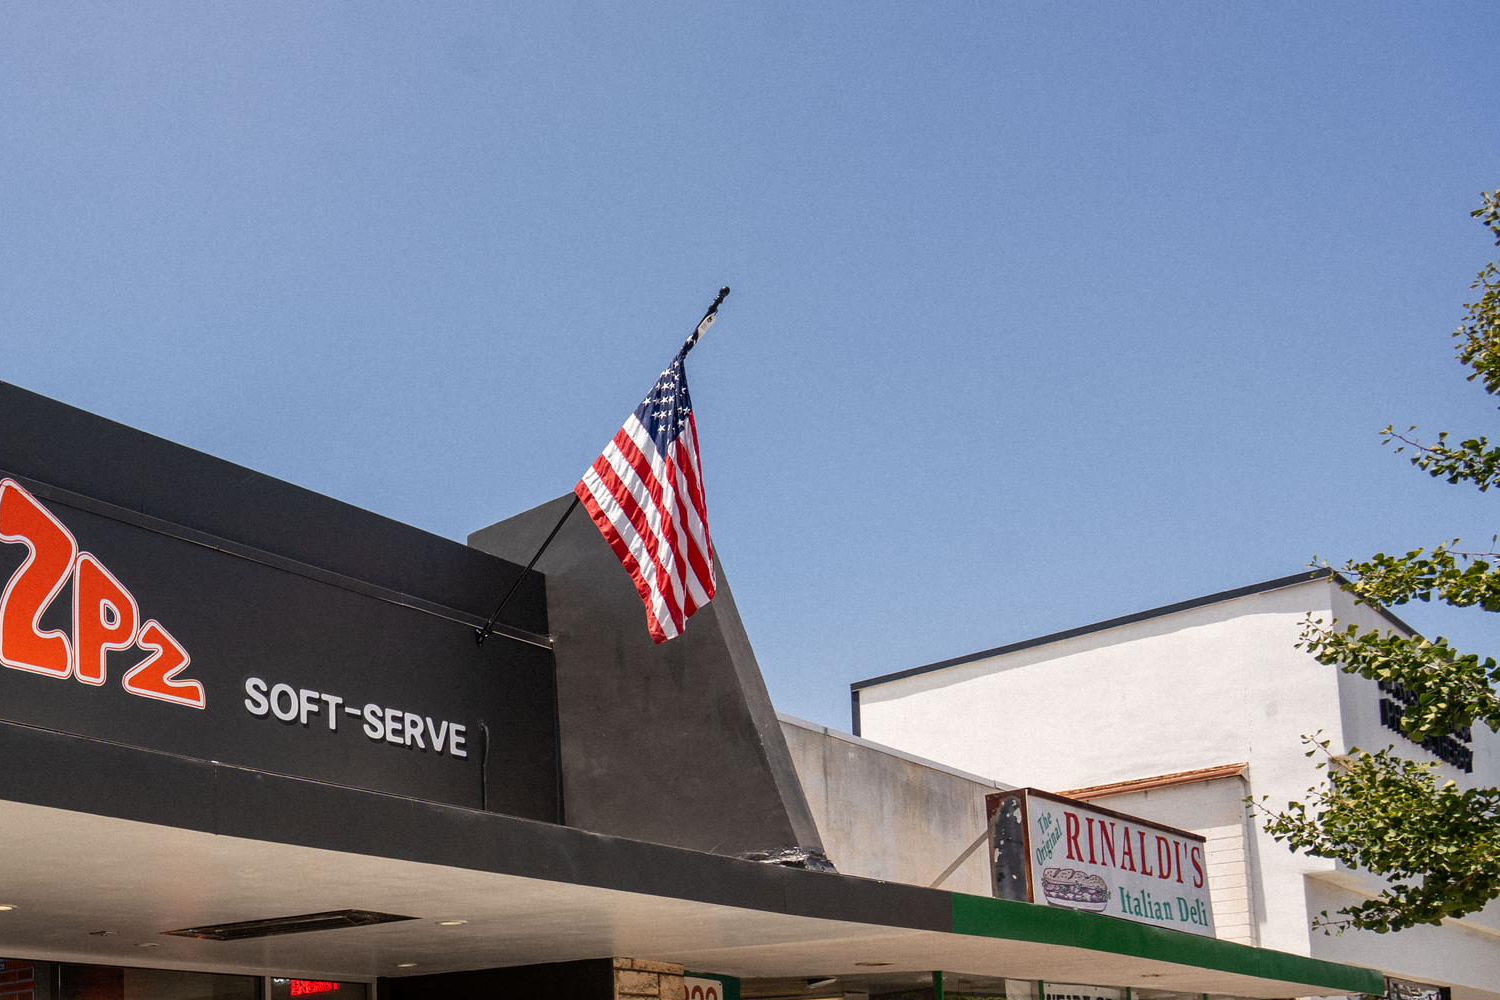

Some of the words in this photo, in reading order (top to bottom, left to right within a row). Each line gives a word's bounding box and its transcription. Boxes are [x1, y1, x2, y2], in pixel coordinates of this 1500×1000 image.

[244, 677, 467, 757] SOFT-SERVE
[1036, 820, 1062, 867] Original
[1038, 811, 1052, 835] The
[1064, 812, 1204, 889] RINALDI'S
[1118, 886, 1174, 921] Italian
[1176, 896, 1209, 927] Deli
